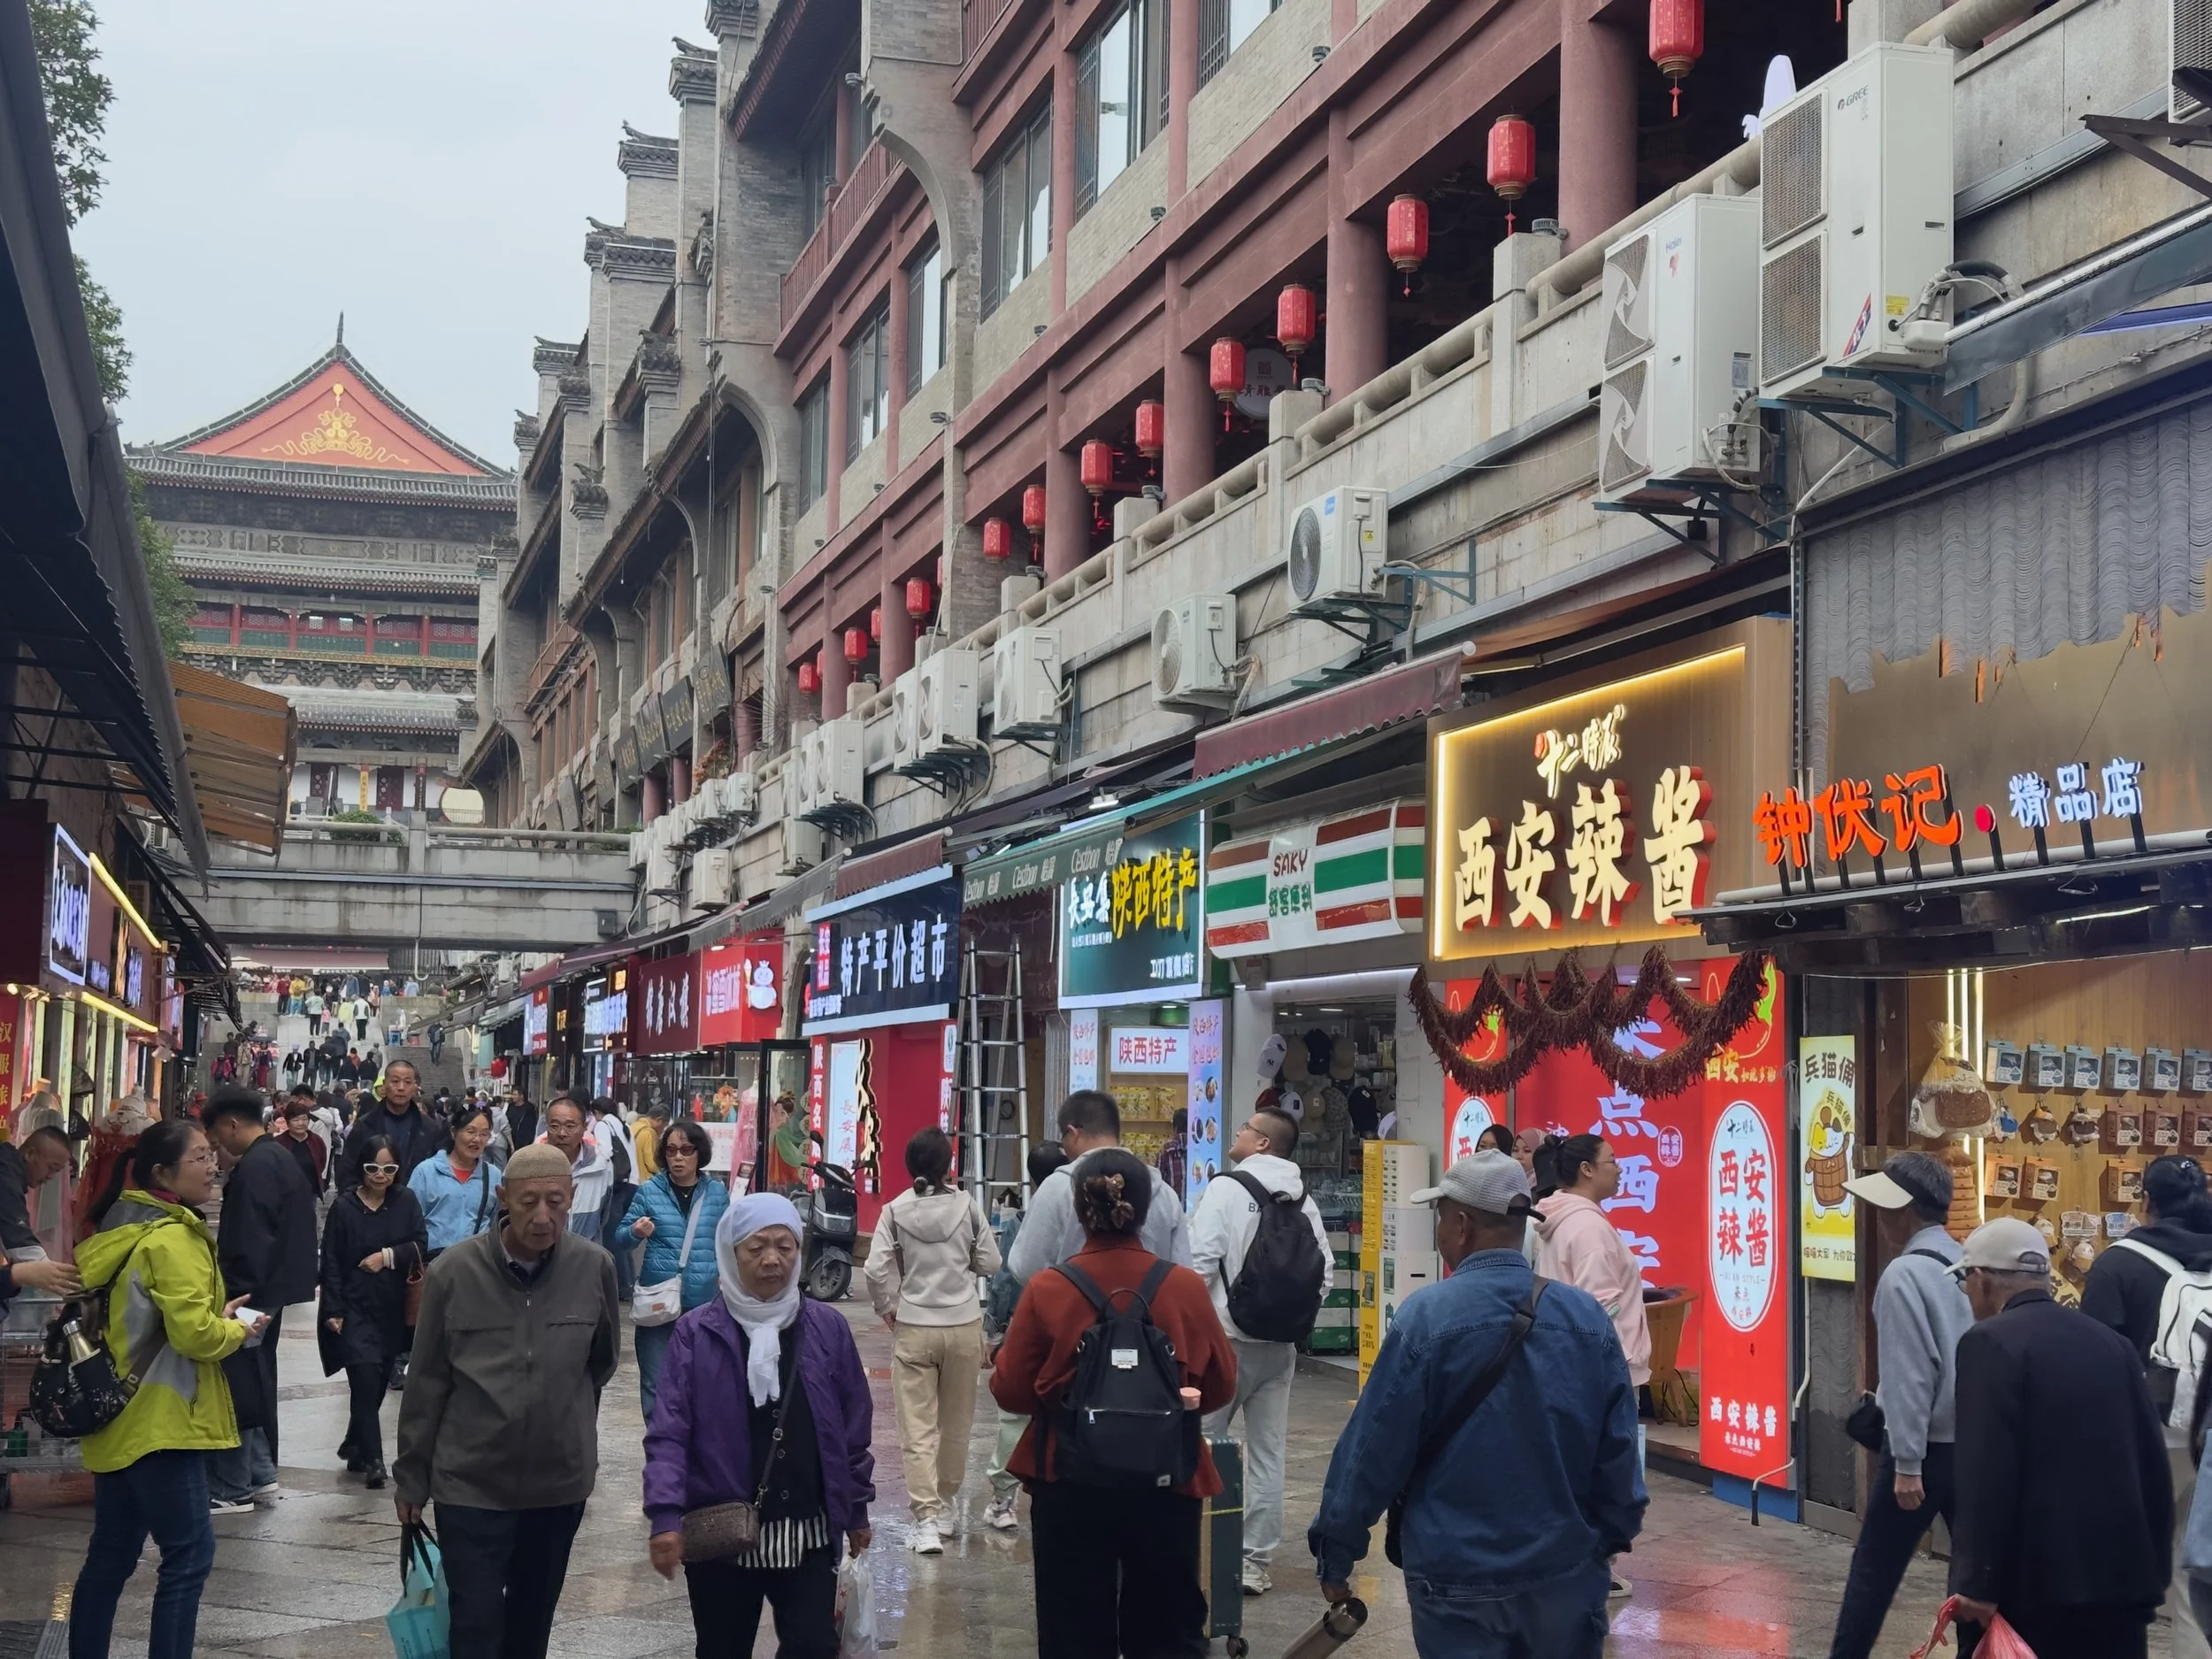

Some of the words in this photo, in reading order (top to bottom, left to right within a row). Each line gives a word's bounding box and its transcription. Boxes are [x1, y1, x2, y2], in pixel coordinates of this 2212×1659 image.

[1846, 84, 1869, 106] GREE
[1753, 763, 1962, 868] 钟伏记
[2008, 757, 2145, 828] 精品店
[1273, 849, 1308, 877] SAKY
[1454, 765, 1715, 931] 西安辣酱
[1112, 847, 1196, 939] 陕西特产
[841, 913, 948, 998] 特产平价超市
[1118, 1036, 1177, 1064] 陕西特产
[1805, 1051, 1855, 1089] 兵猫俑
[1718, 1148, 1766, 1204] 西安
[1710, 1395, 1777, 1438] 西安辣酱
